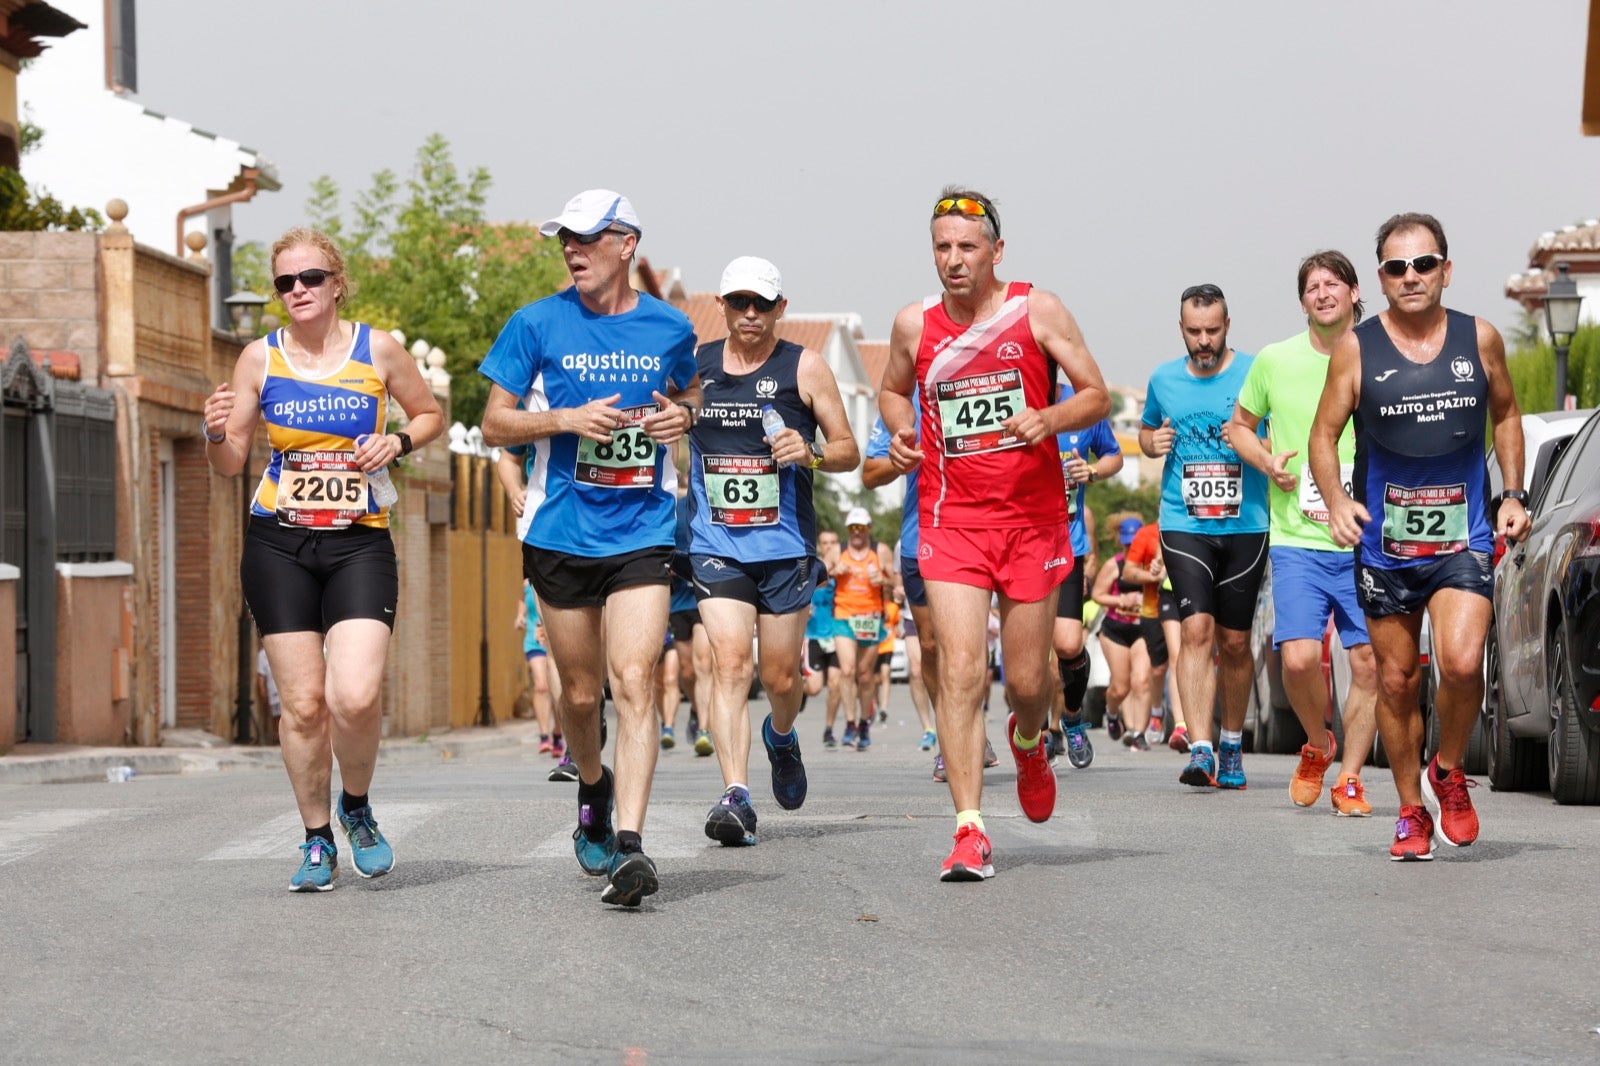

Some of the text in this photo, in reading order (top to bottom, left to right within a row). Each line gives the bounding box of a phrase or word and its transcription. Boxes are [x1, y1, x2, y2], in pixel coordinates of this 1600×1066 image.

[562, 350, 660, 375] agustinos
[580, 373, 648, 382] GRANADA
[274, 393, 369, 420] agustinos
[700, 408, 762, 418] AZITO a PAZI
[956, 395, 1013, 429] 425
[1380, 403, 1424, 417] PAZITO
[1436, 397, 1477, 410] PAZITO
[287, 413, 358, 425] GRANADA
[722, 419, 746, 427] Motril
[1417, 412, 1445, 423] Motril
[595, 432, 653, 461] 835
[302, 453, 315, 462] GRA
[344, 452, 355, 462] FON
[291, 476, 361, 502] 2205
[723, 478, 759, 504] 63
[1189, 480, 1238, 498] 3055
[1417, 489, 1438, 498] PREMIO
[1439, 489, 1446, 497] DE
[1405, 510, 1446, 536] 52
[1044, 556, 1068, 571] Joma
